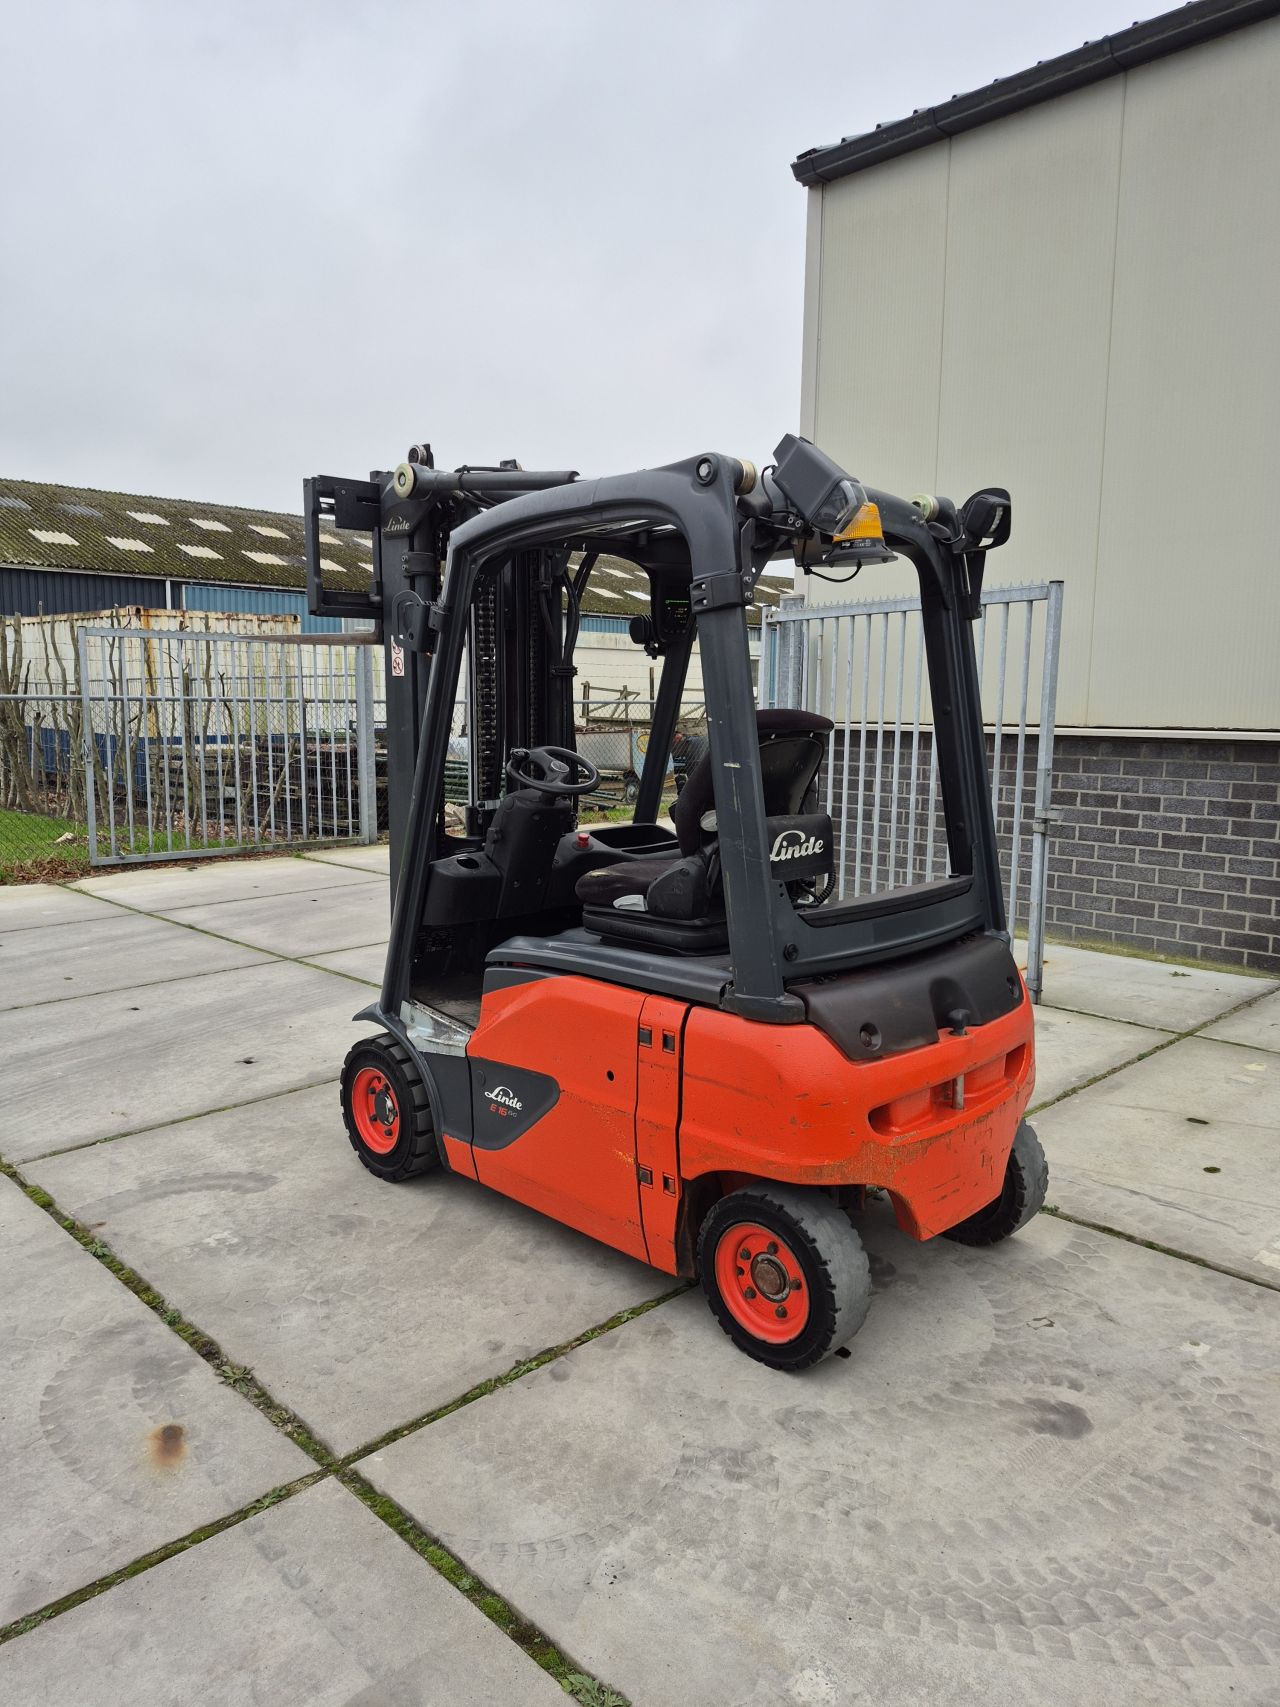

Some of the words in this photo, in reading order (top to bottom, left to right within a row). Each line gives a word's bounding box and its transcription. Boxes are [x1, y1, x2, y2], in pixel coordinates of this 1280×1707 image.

[384, 515, 410, 532] Linde
[769, 830, 824, 861] Linde
[484, 1086, 522, 1110] Linde
[490, 1103, 497, 1112] E
